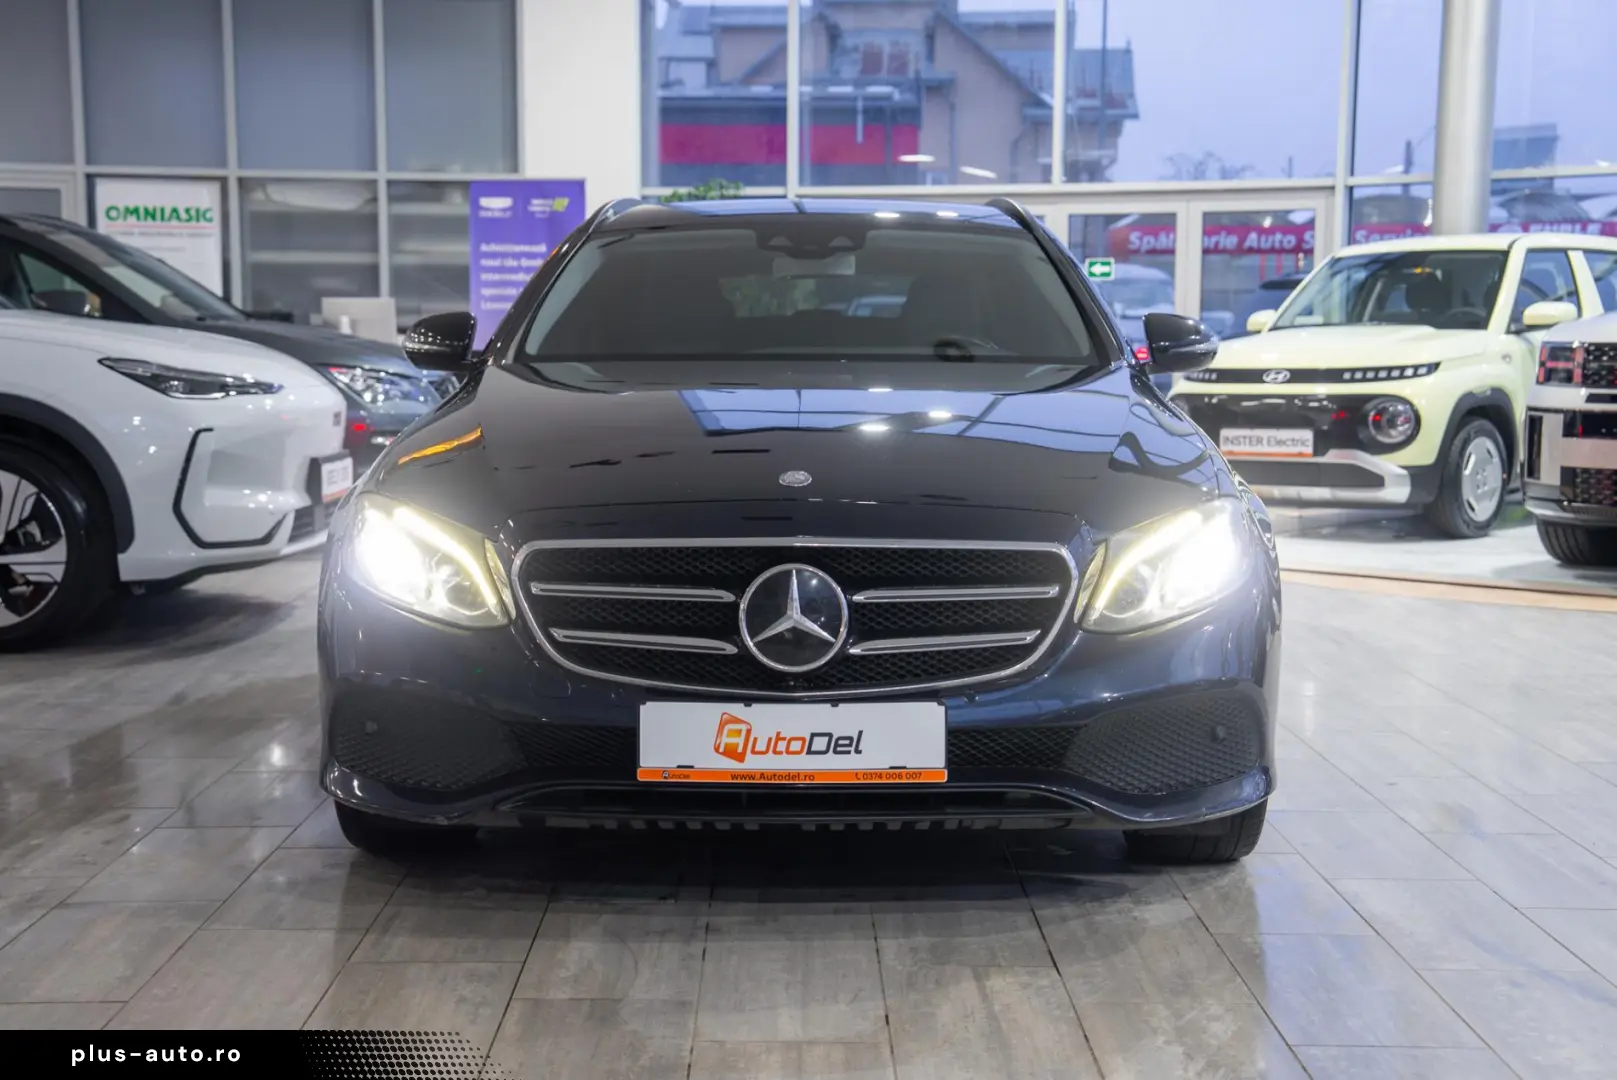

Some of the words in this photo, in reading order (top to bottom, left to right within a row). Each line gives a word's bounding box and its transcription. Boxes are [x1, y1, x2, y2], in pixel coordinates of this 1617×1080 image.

[105, 205, 214, 223] OMNIASIG
[1244, 230, 1296, 249] Auto
[1223, 435, 1264, 447] INSTER
[1267, 435, 1311, 448] Electric
[716, 719, 864, 758] AutoDel
[730, 772, 815, 782] www.Autodel.ro
[862, 772, 883, 781] 0374
[885, 772, 903, 780] 006
[905, 771, 922, 780] 007
